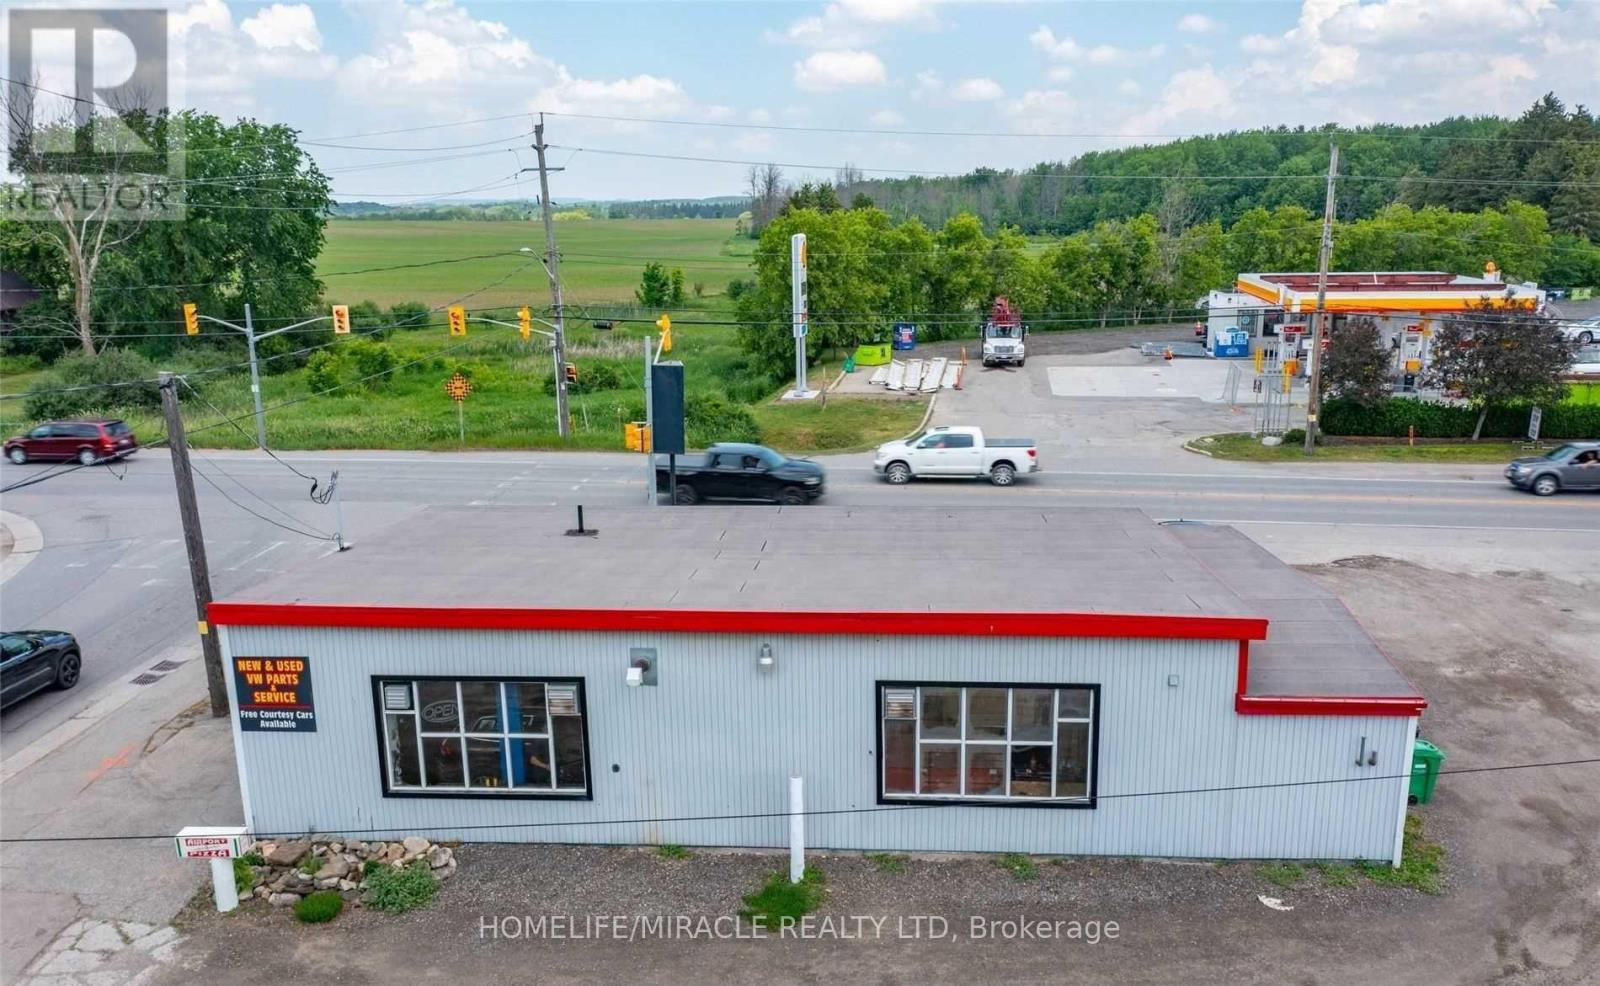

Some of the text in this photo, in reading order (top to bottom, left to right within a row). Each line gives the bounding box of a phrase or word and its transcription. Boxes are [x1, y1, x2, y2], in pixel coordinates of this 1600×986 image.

[237, 660, 304, 671] NEW & USED
[246, 673, 299, 684] VW PARTS
[254, 692, 296, 703] SERVICE
[240, 710, 314, 720] Free Courtesy Cars
[424, 703, 458, 719] OPEN
[260, 720, 296, 728] Available
[186, 838, 228, 846] AIRPORT
